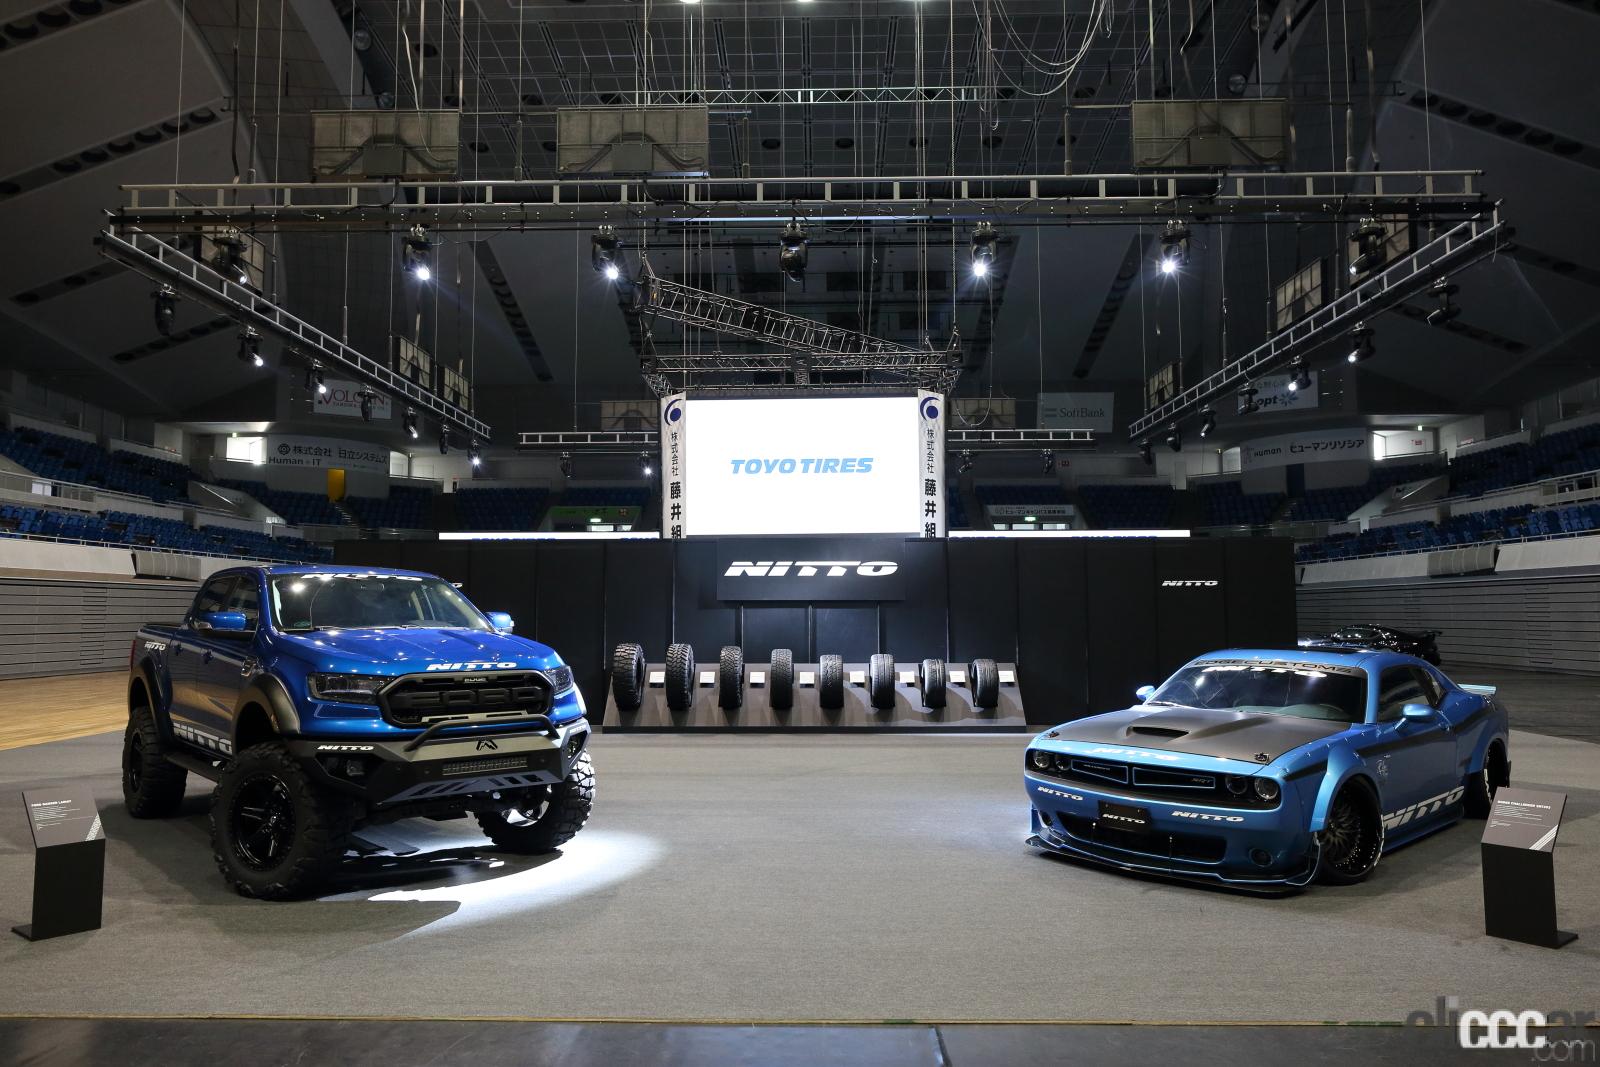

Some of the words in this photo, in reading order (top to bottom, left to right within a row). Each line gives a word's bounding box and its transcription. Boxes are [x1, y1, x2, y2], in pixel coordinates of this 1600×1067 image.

[321, 387, 386, 406] VOLCN
[1060, 407, 1105, 418] SoftBank
[1290, 439, 1365, 454] ヒューマンリソシア
[293, 445, 332, 457] 株式会社
[338, 448, 388, 464] 日立システムズ
[268, 456, 304, 466] Human
[731, 459, 796, 474] TOYO
[800, 457, 874, 473] TIRES
[723, 561, 898, 577] NITTO
[301, 573, 423, 582] NITTO
[144, 641, 167, 651] NITTO
[426, 662, 518, 671] NITTO
[1090, 748, 1180, 760] NITTO
[1037, 786, 1084, 801] NITTO
[1382, 785, 1465, 830] NITTO
[1102, 813, 1146, 824] NITTO
[1172, 810, 1245, 822] NITTO
